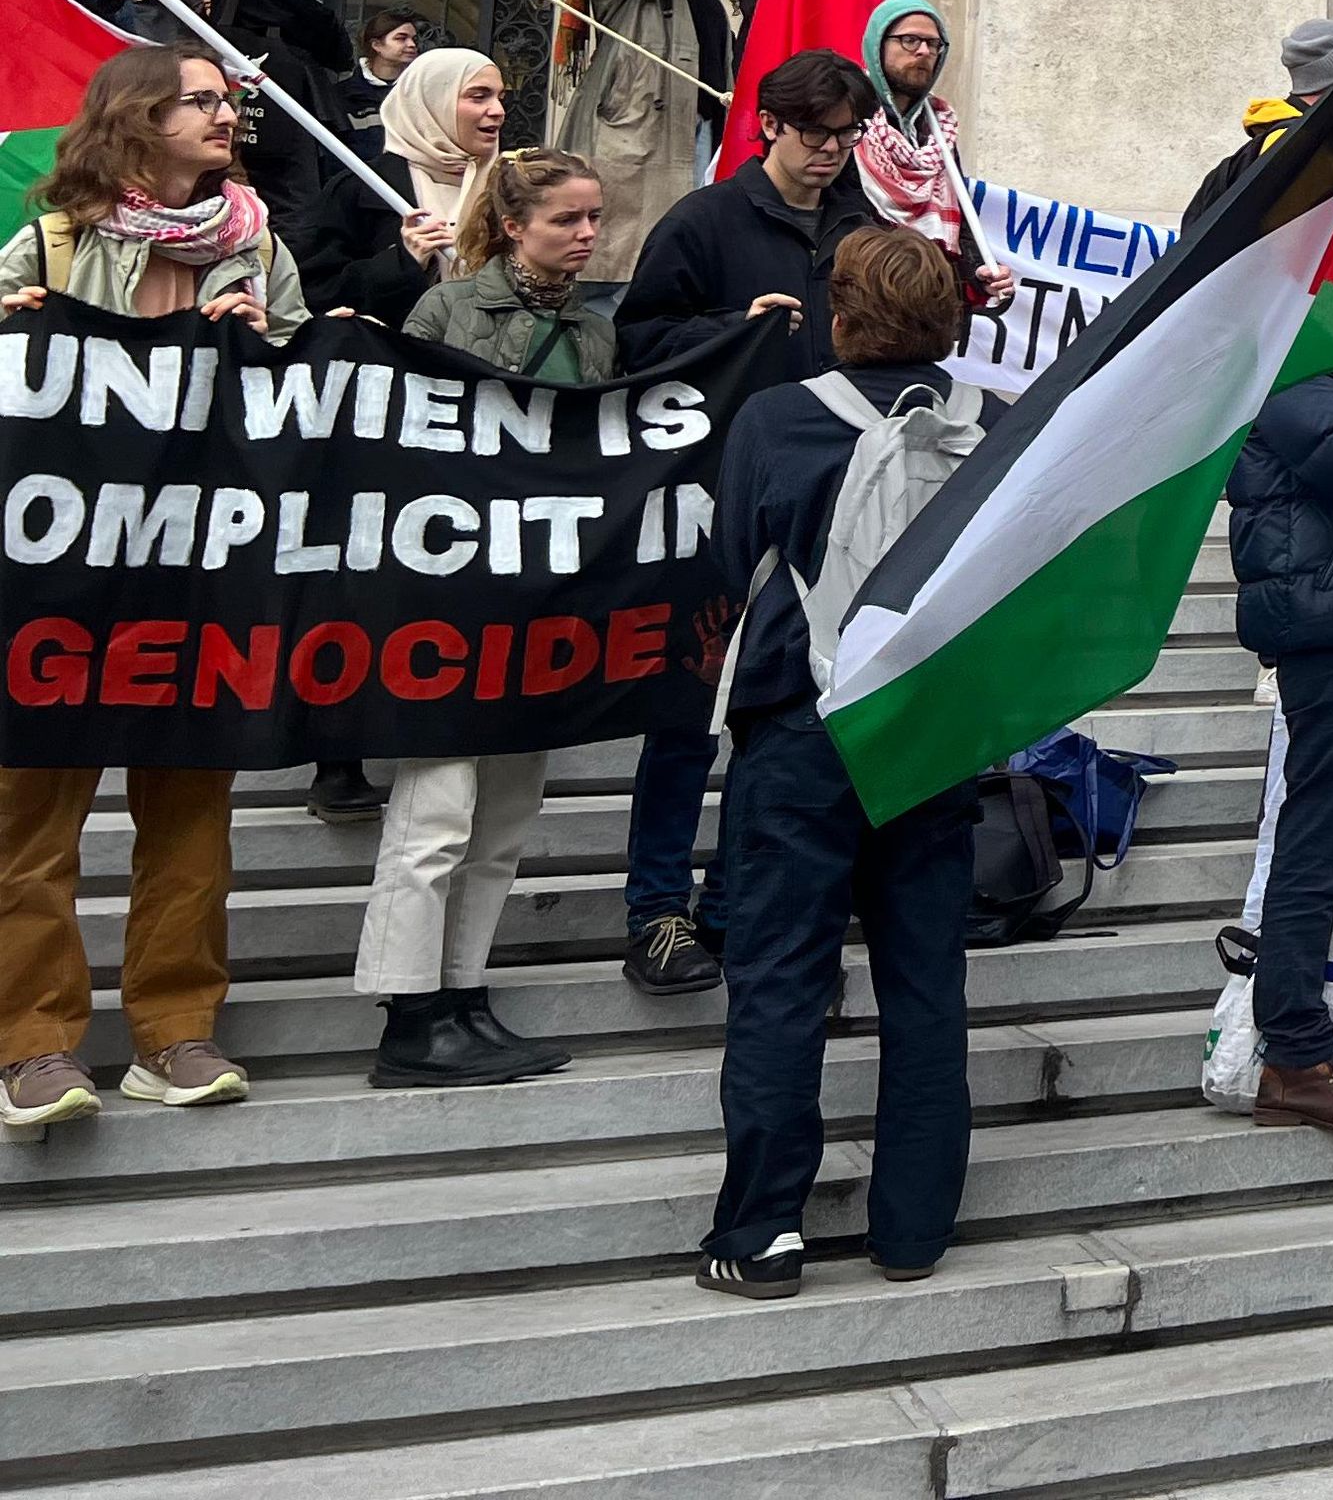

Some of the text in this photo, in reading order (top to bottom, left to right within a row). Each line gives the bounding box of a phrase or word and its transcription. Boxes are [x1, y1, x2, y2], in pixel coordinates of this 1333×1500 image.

[246, 106, 265, 118] NG
[1007, 188, 1177, 278] WIEN
[957, 277, 1112, 371] RTN
[0, 332, 712, 457] UNI WIEN IS
[4, 473, 605, 576] OMPLICIT
[6, 602, 673, 711] GENOCIDE
